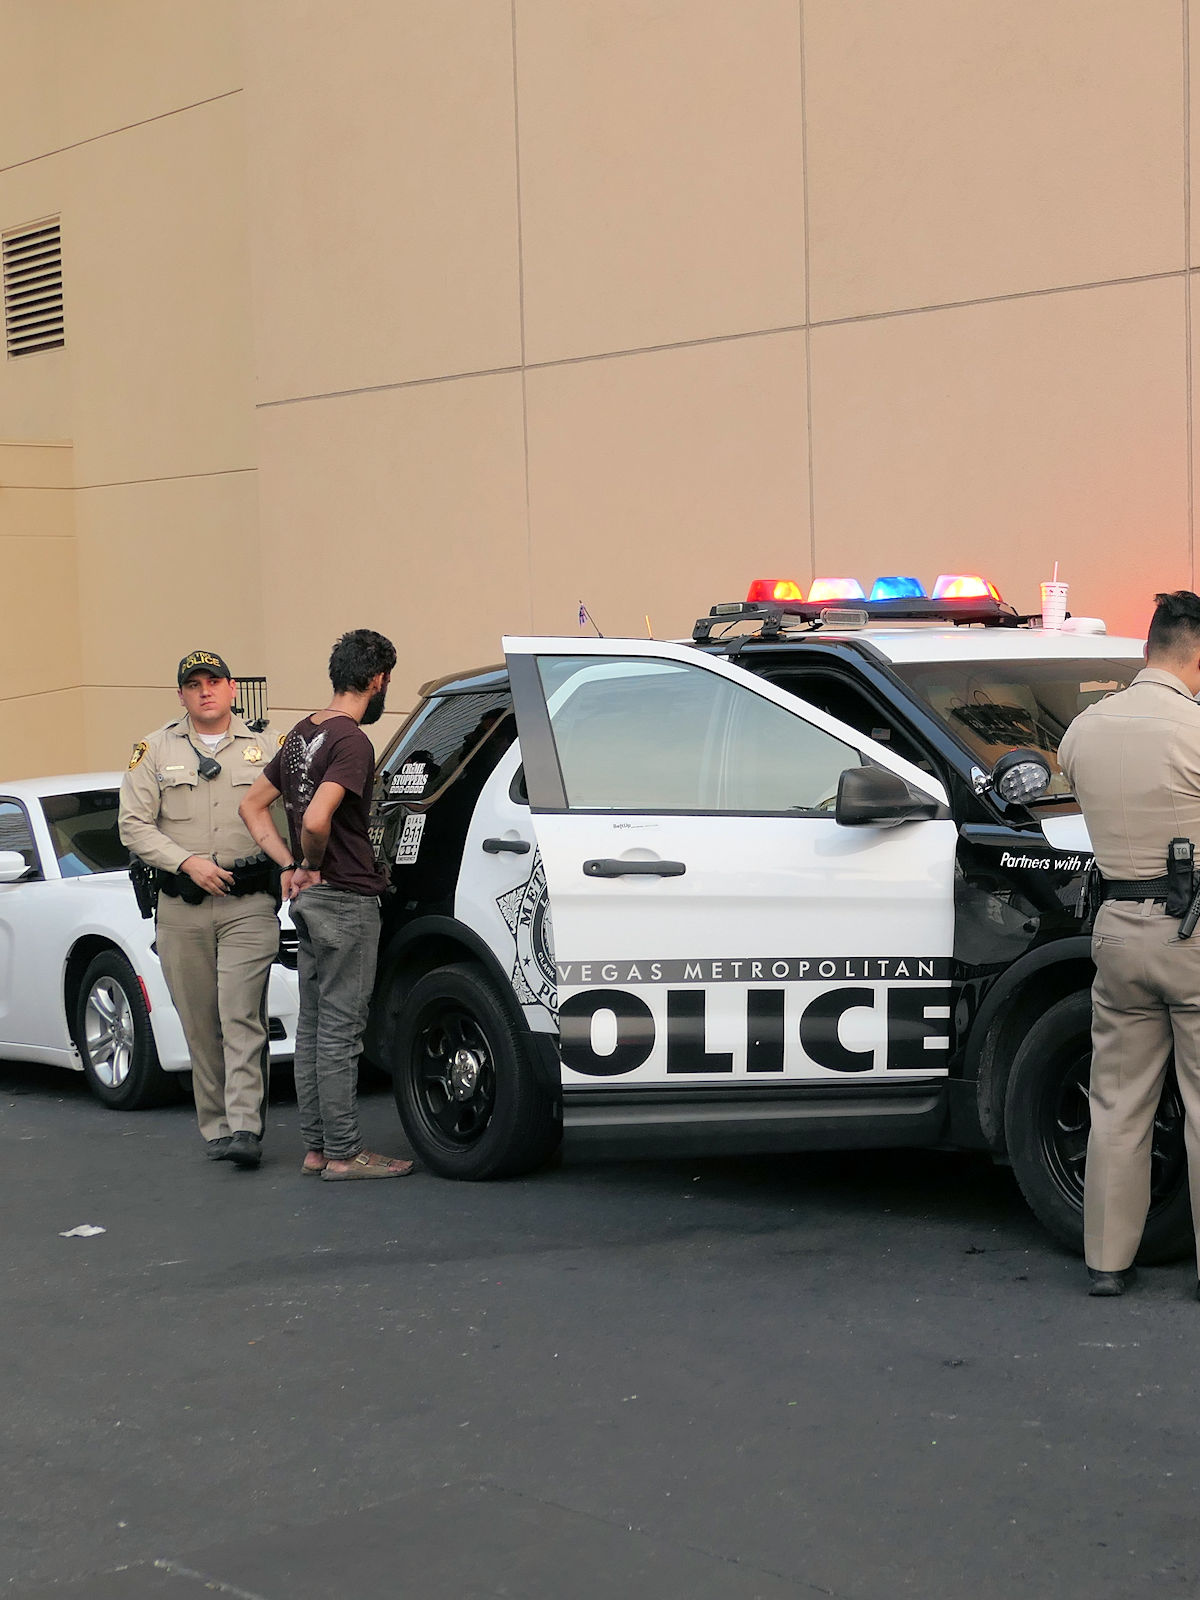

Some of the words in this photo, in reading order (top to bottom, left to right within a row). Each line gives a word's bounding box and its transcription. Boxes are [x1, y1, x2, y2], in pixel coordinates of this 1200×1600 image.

[181, 656, 221, 673] POLICE
[391, 774, 429, 786] STOPPERS
[1000, 852, 1051, 870] Partners
[1054, 856, 1082, 871] with
[538, 952, 556, 980] CLARK
[558, 962, 664, 983] VEGAS
[684, 960, 935, 980] METROPOLITAN
[560, 987, 950, 1076] OLICE
